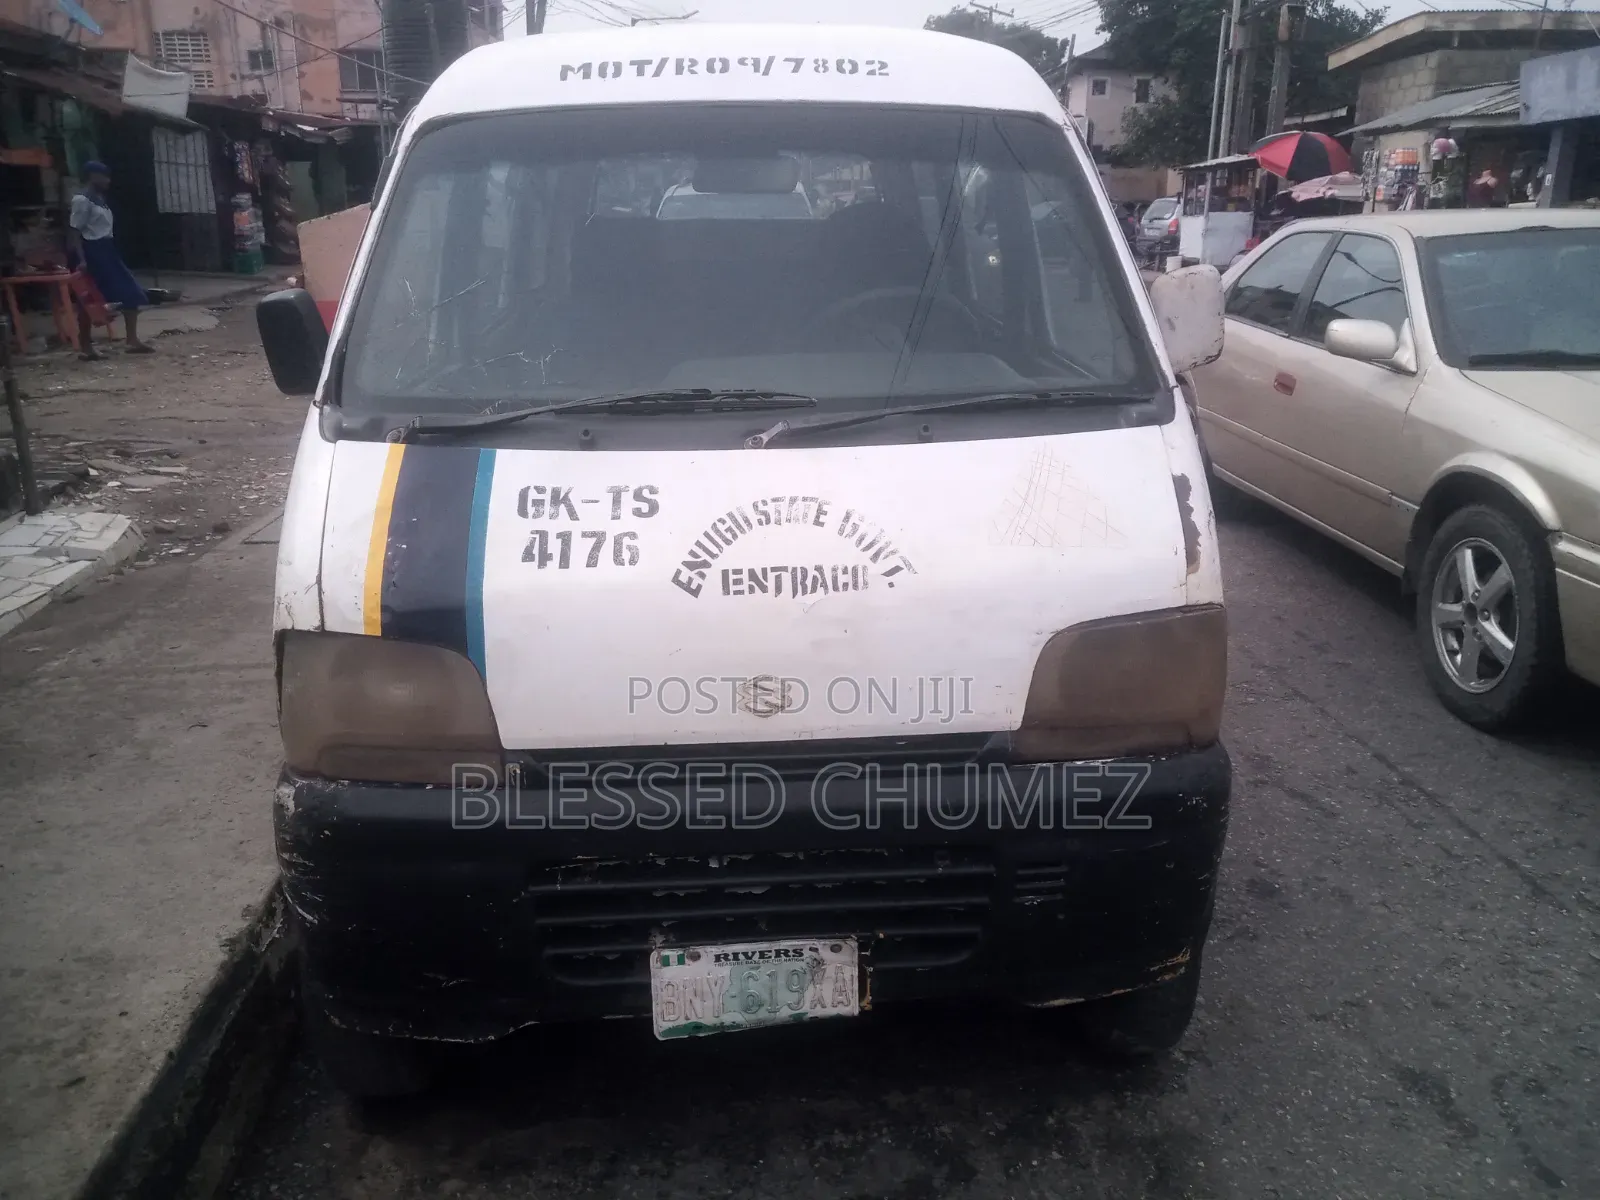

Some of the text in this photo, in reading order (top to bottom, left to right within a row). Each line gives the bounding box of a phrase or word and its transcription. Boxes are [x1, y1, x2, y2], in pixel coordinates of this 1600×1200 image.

[517, 484, 660, 521] GK-TS
[521, 529, 640, 569] 4176
[671, 505, 754, 599] ENUGU
[752, 495, 832, 528] STATE
[721, 564, 869, 599] ENTRACO
[713, 948, 805, 963] RIVERS
